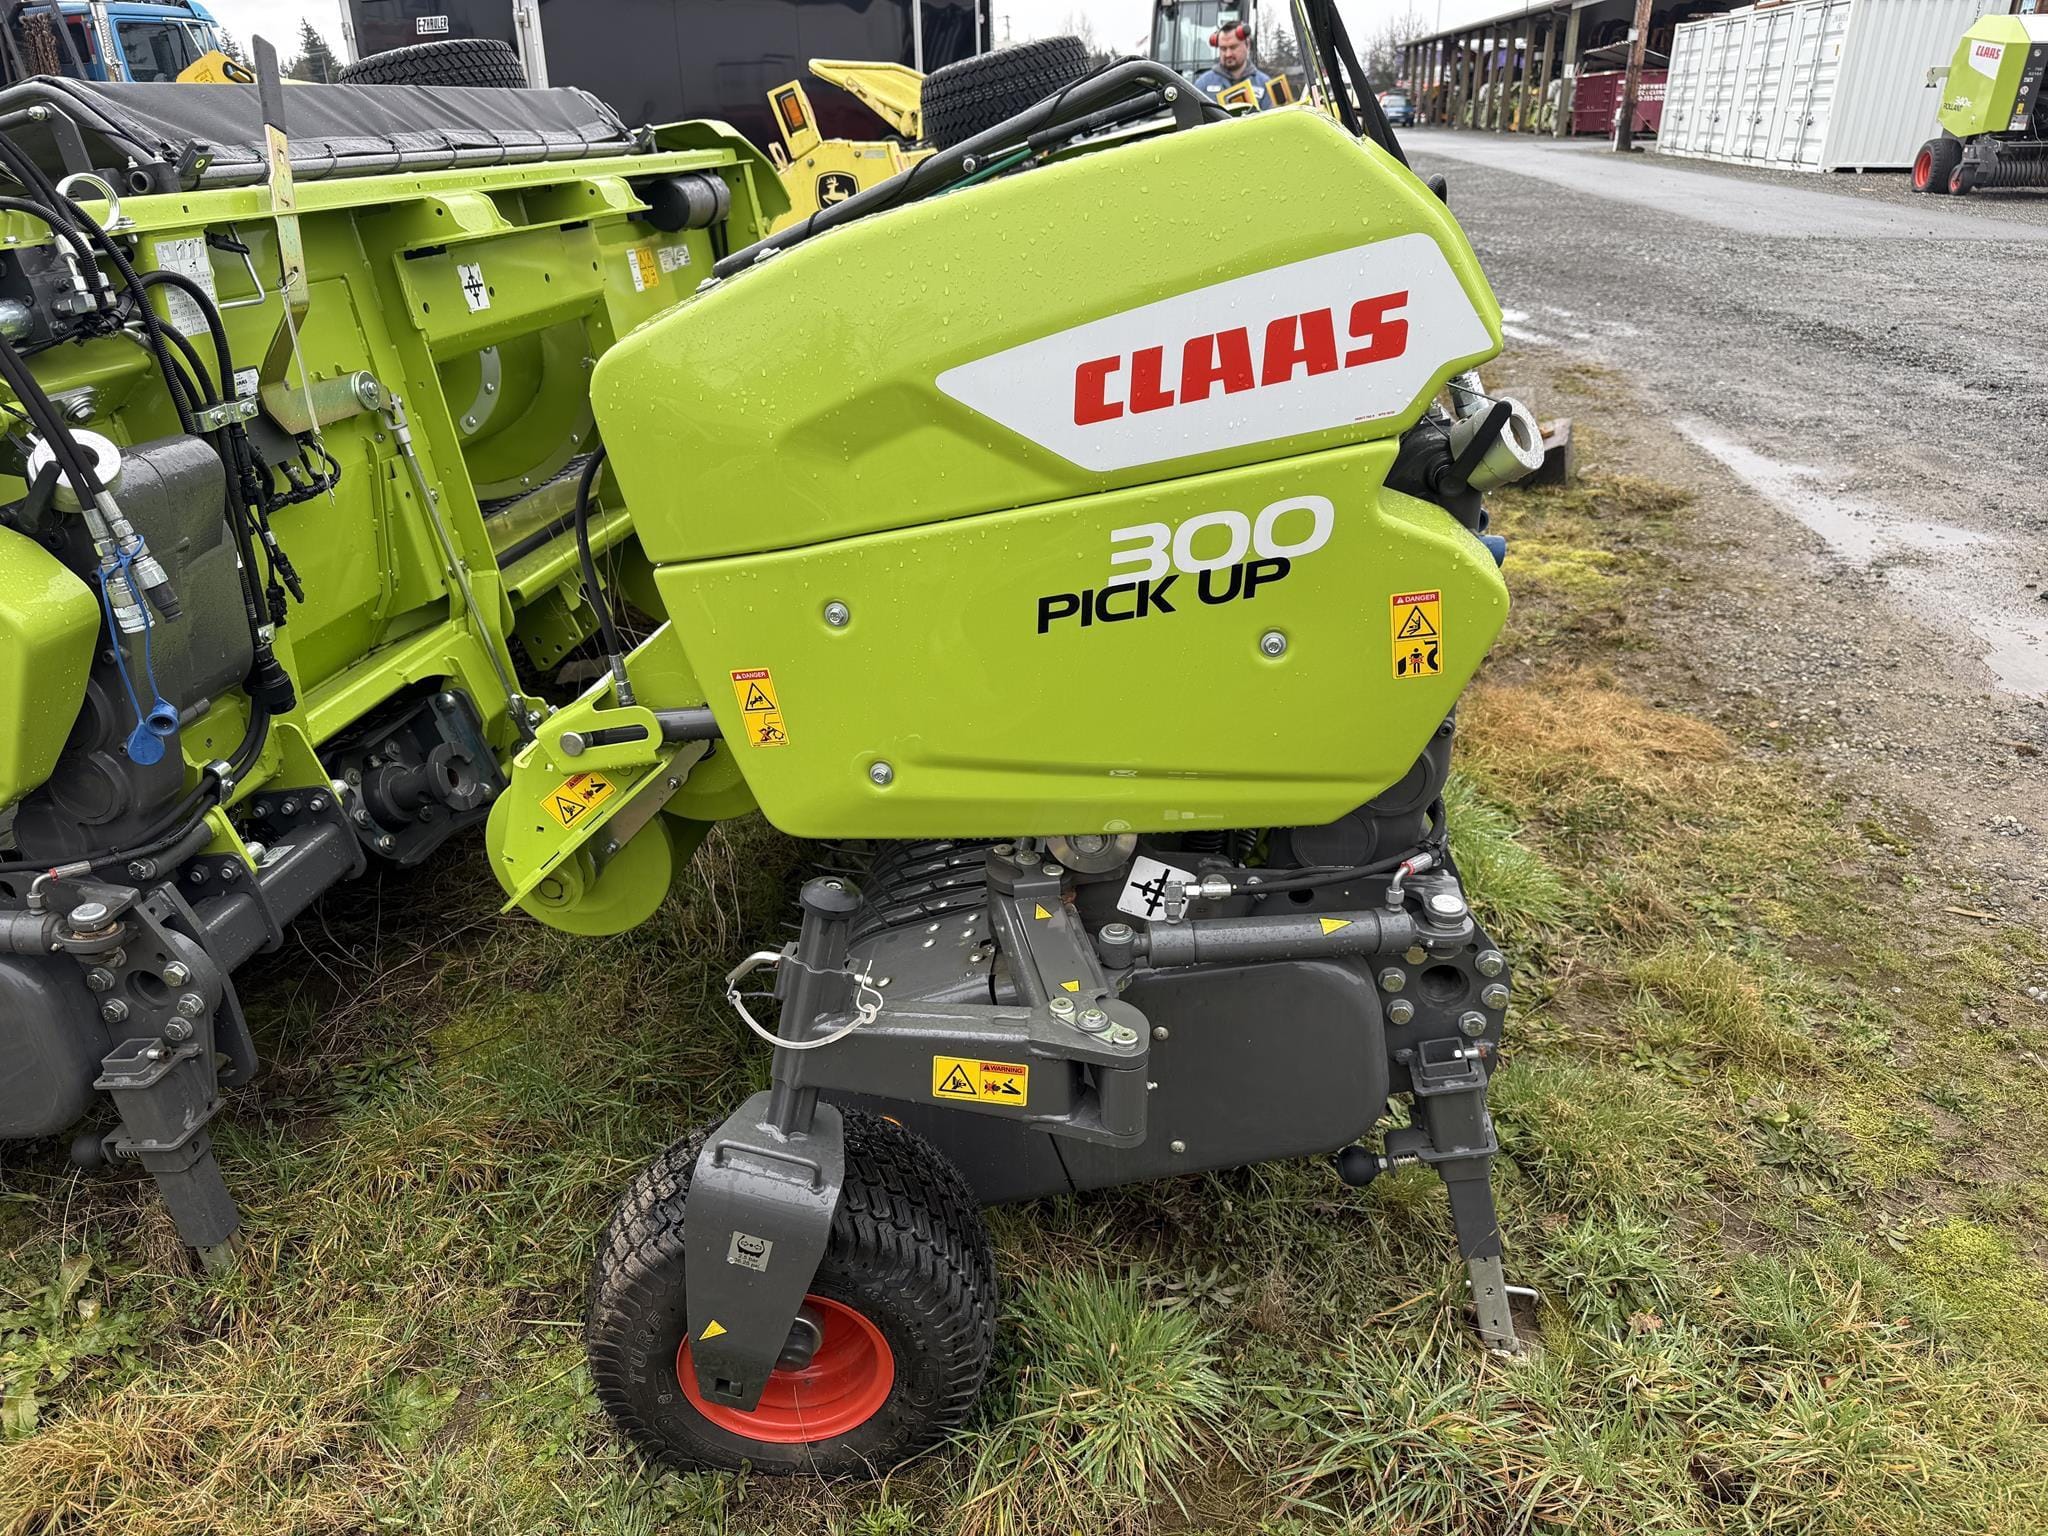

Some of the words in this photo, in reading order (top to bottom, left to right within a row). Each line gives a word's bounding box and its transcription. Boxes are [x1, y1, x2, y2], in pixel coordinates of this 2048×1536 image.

[1975, 45, 2001, 60] CLAAS
[1074, 290, 1409, 426] CLAAS
[1108, 495, 1335, 586] 300
[1037, 574, 1180, 634] PICK
[1197, 557, 1291, 605] UP
[1404, 593, 1436, 603] DANGER
[742, 671, 766, 679] DANGER
[990, 1065, 1023, 1073] WARNING
[629, 1310, 661, 1384] TURF
